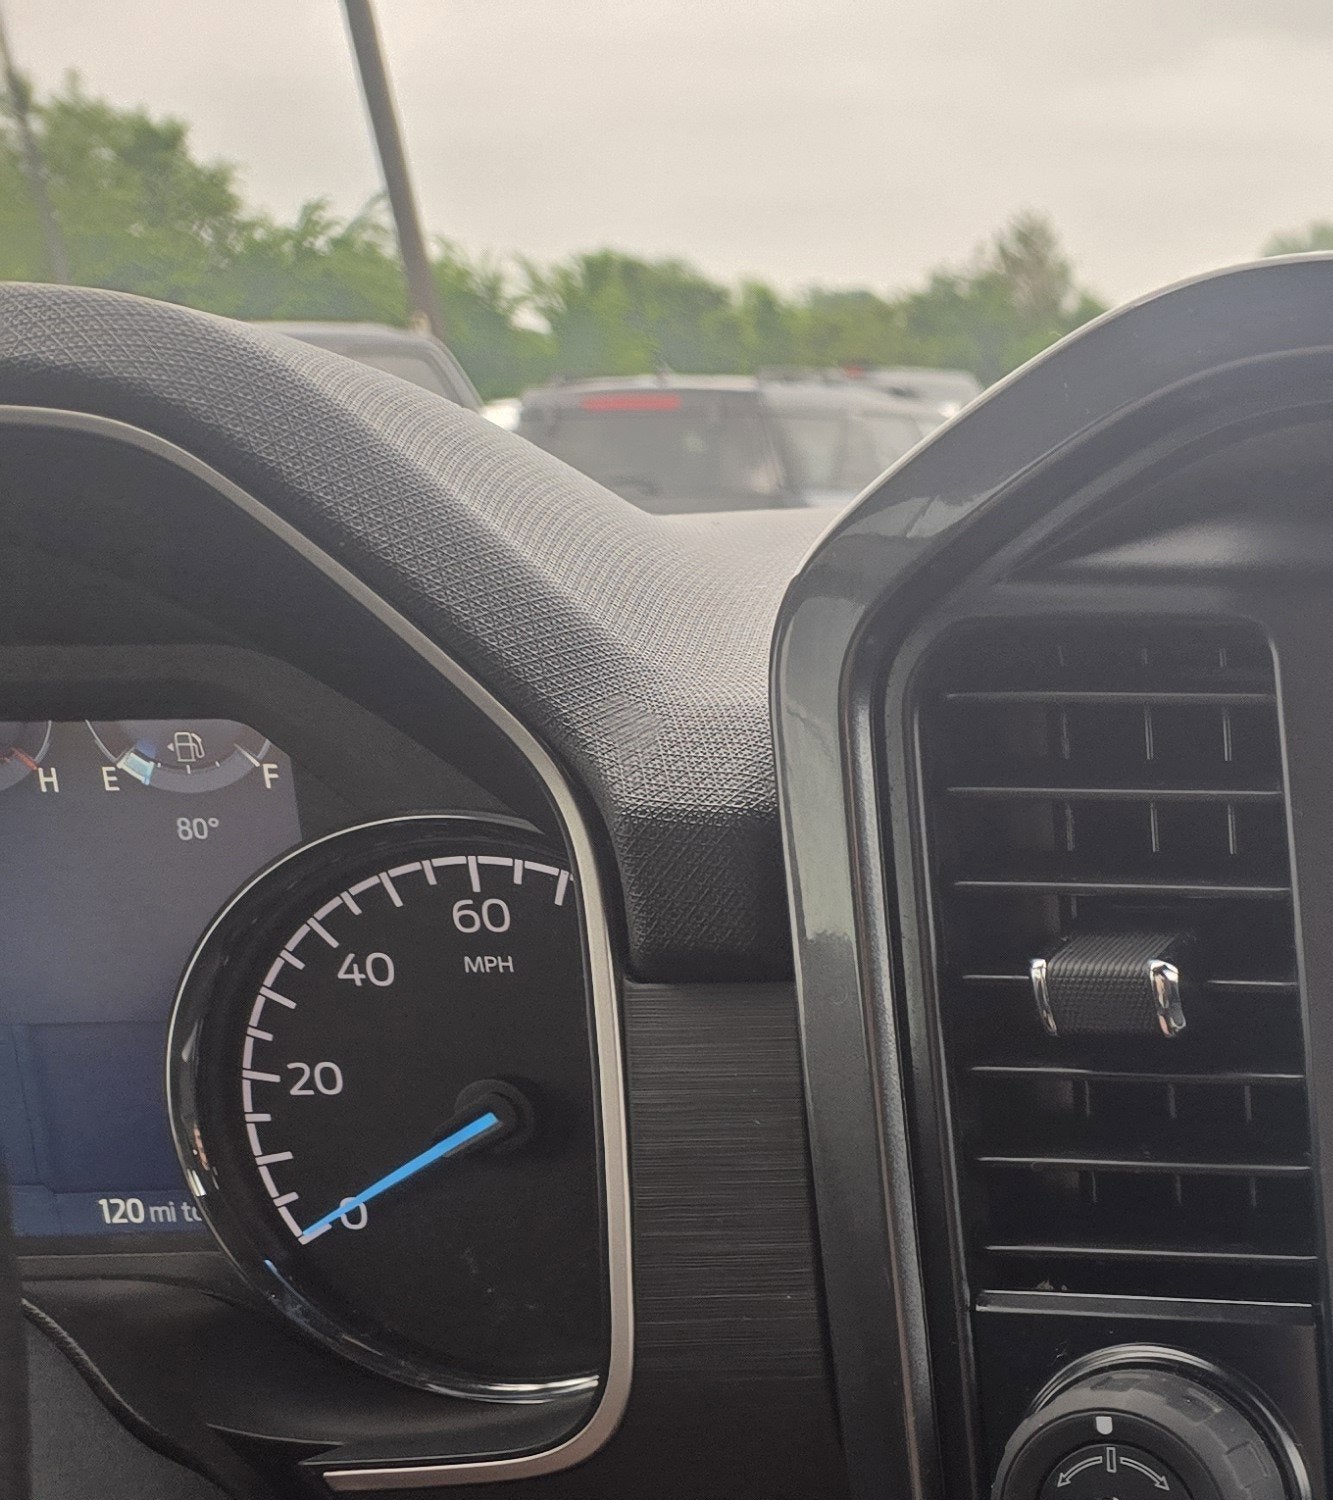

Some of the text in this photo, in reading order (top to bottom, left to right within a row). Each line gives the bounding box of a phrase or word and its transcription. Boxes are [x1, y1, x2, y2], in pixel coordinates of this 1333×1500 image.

[38, 768, 60, 794] H
[101, 766, 121, 792] E
[262, 764, 279, 790] F
[176, 818, 219, 842] 80°
[452, 899, 511, 934] 60
[337, 953, 395, 988] 40
[464, 956, 514, 974] MPH
[286, 1062, 343, 1097] 20
[98, 1198, 145, 1225] 120
[149, 1202, 177, 1224] mi
